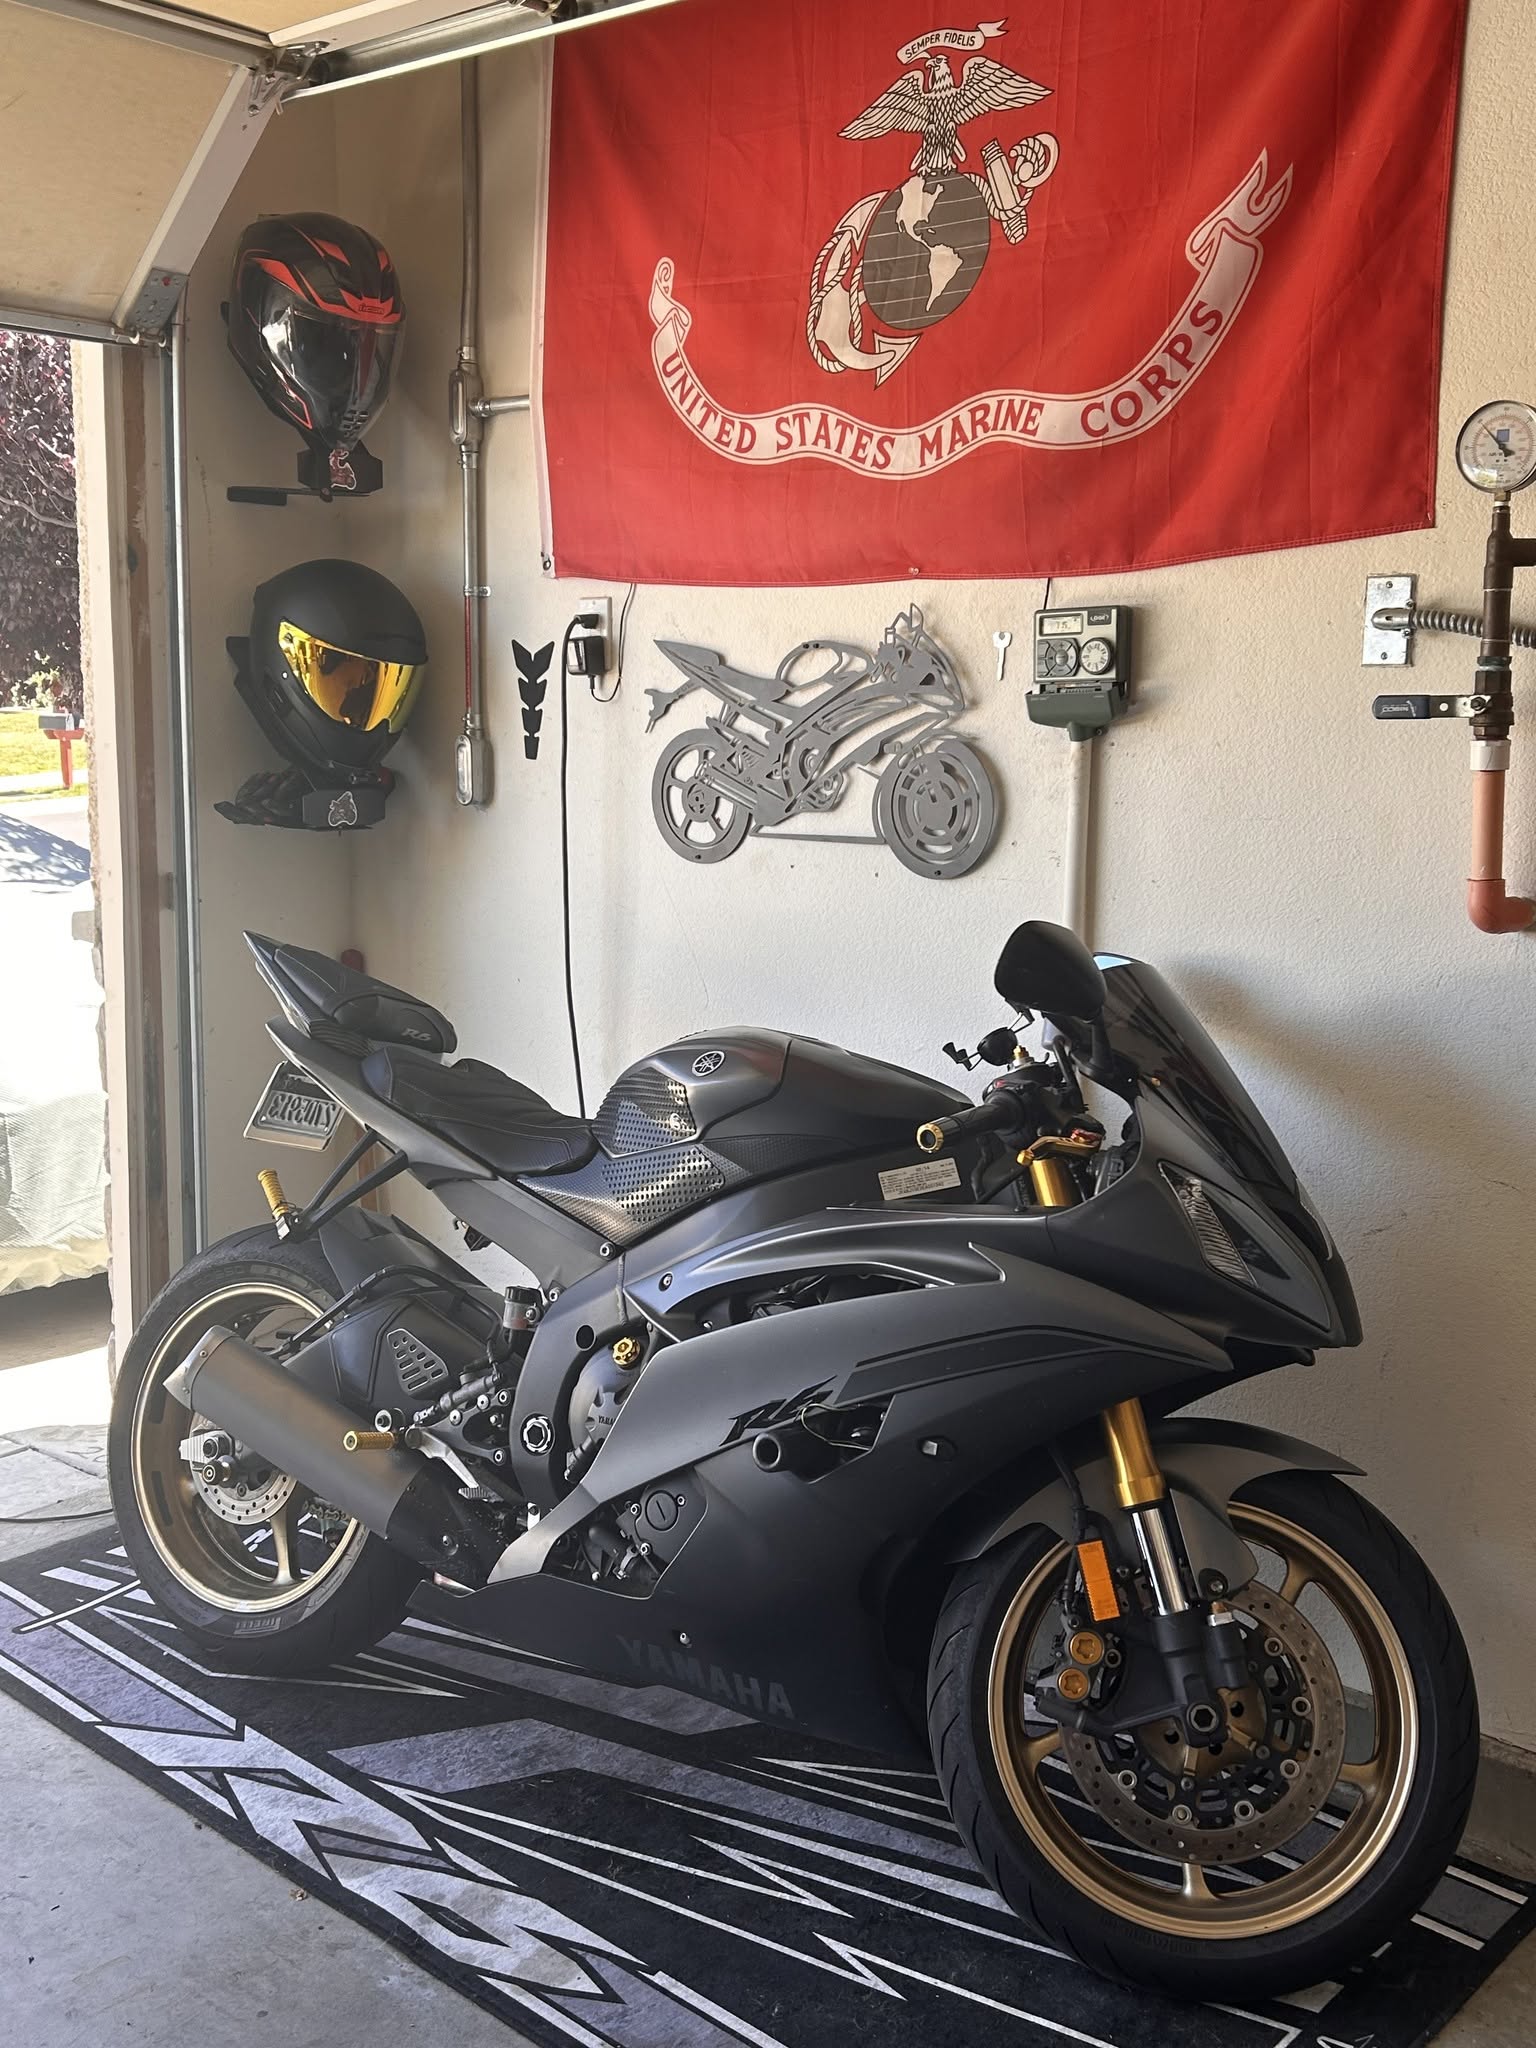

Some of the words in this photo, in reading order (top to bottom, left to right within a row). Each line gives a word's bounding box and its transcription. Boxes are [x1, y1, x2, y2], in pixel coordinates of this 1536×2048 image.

[905, 33, 940, 59] SEMPER
[943, 32, 976, 47] FIDELIS
[661, 348, 756, 454] UNITED
[775, 411, 896, 470] STATES
[918, 398, 1045, 468] MARINE
[1080, 301, 1224, 438] CORPS
[615, 1633, 795, 1720] YAMAHA
